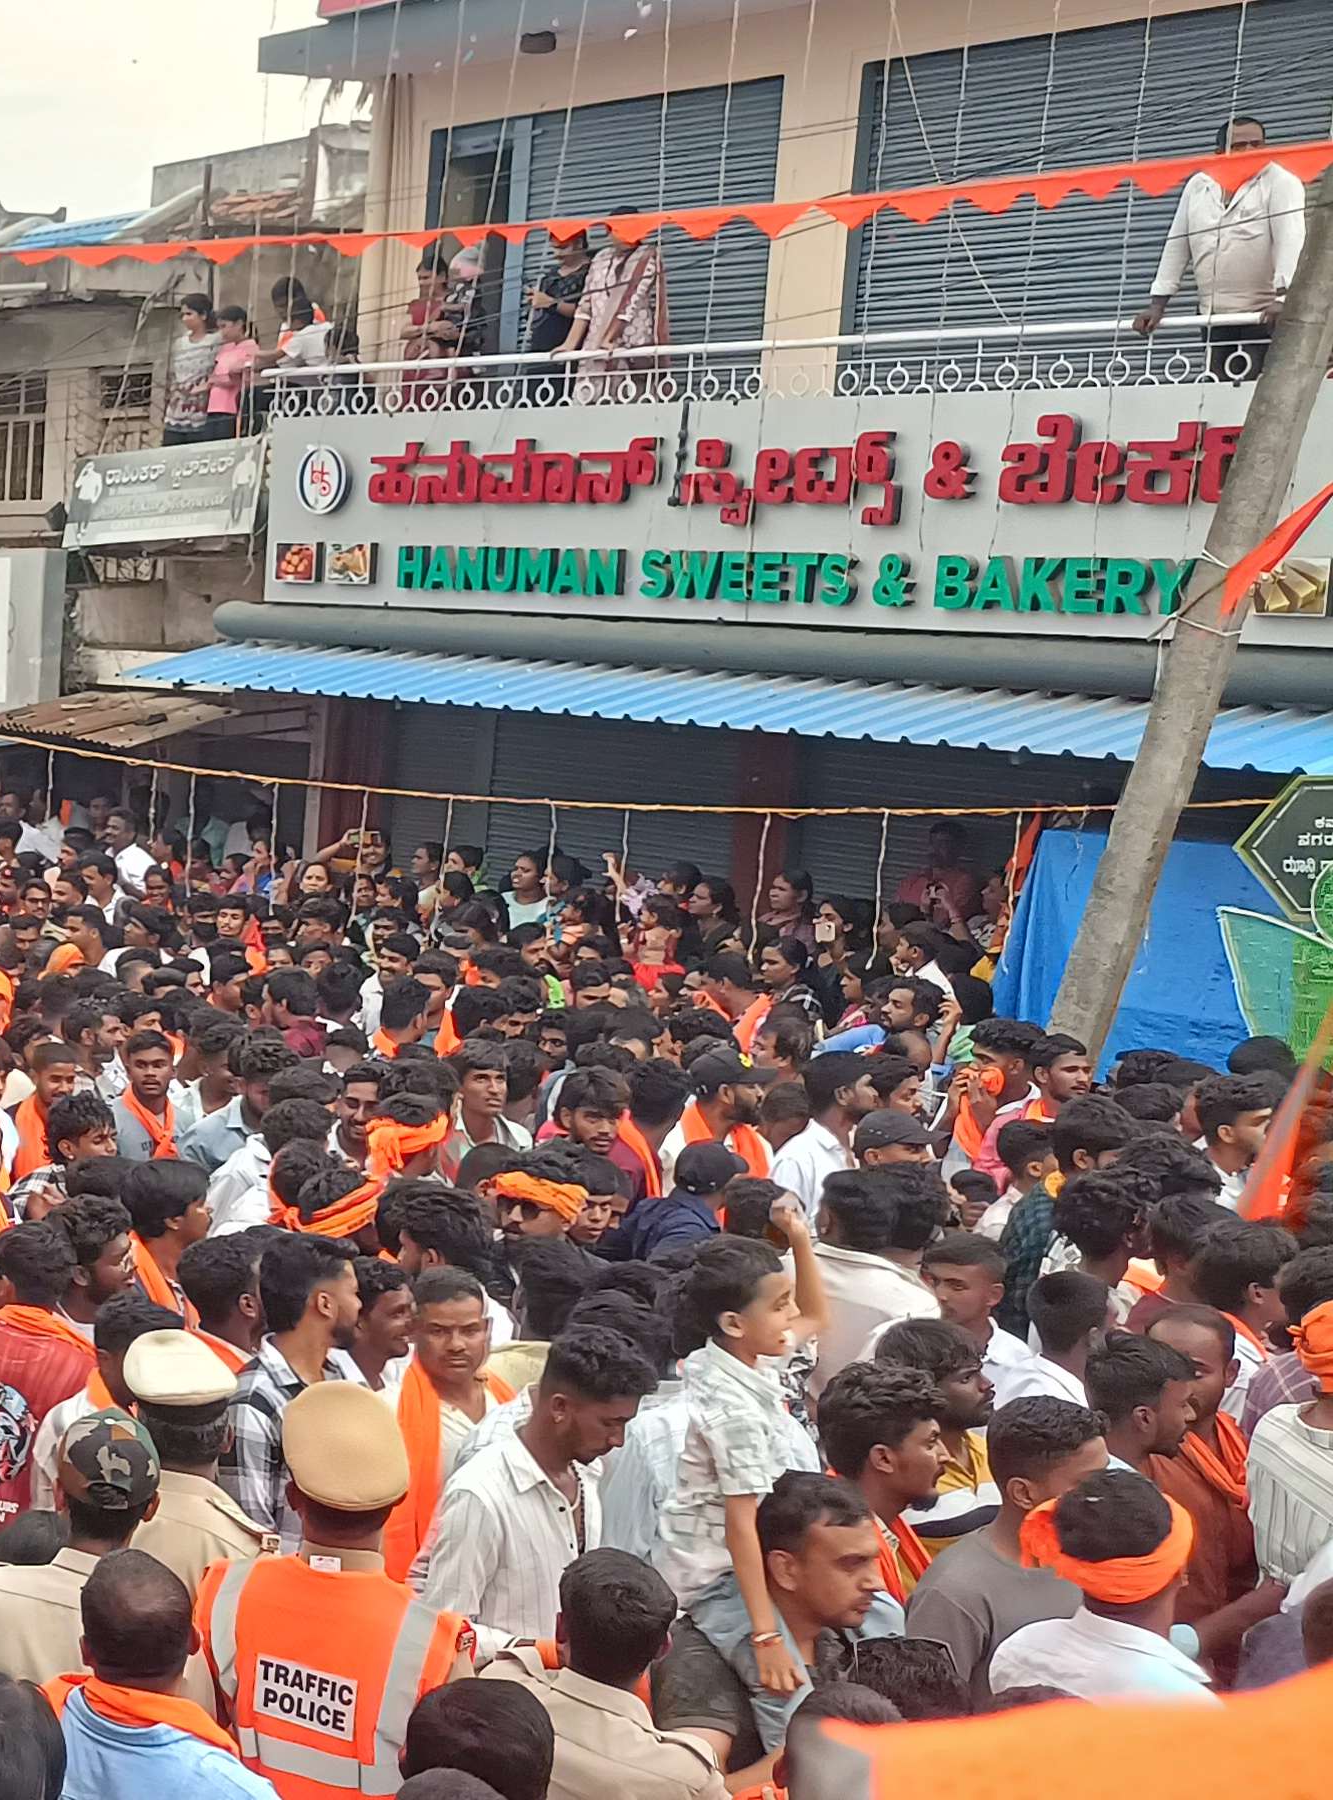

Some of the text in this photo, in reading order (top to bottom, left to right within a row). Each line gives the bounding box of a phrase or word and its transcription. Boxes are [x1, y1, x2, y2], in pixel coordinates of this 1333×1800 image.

[368, 437, 662, 505] ಹನುಮಾನ್
[924, 441, 975, 500] &
[397, 545, 1195, 616] HANUMAN SWEETS & BAKERY
[259, 1659, 354, 1706] TRAFFIC
[263, 1687, 346, 1732] POLICE
